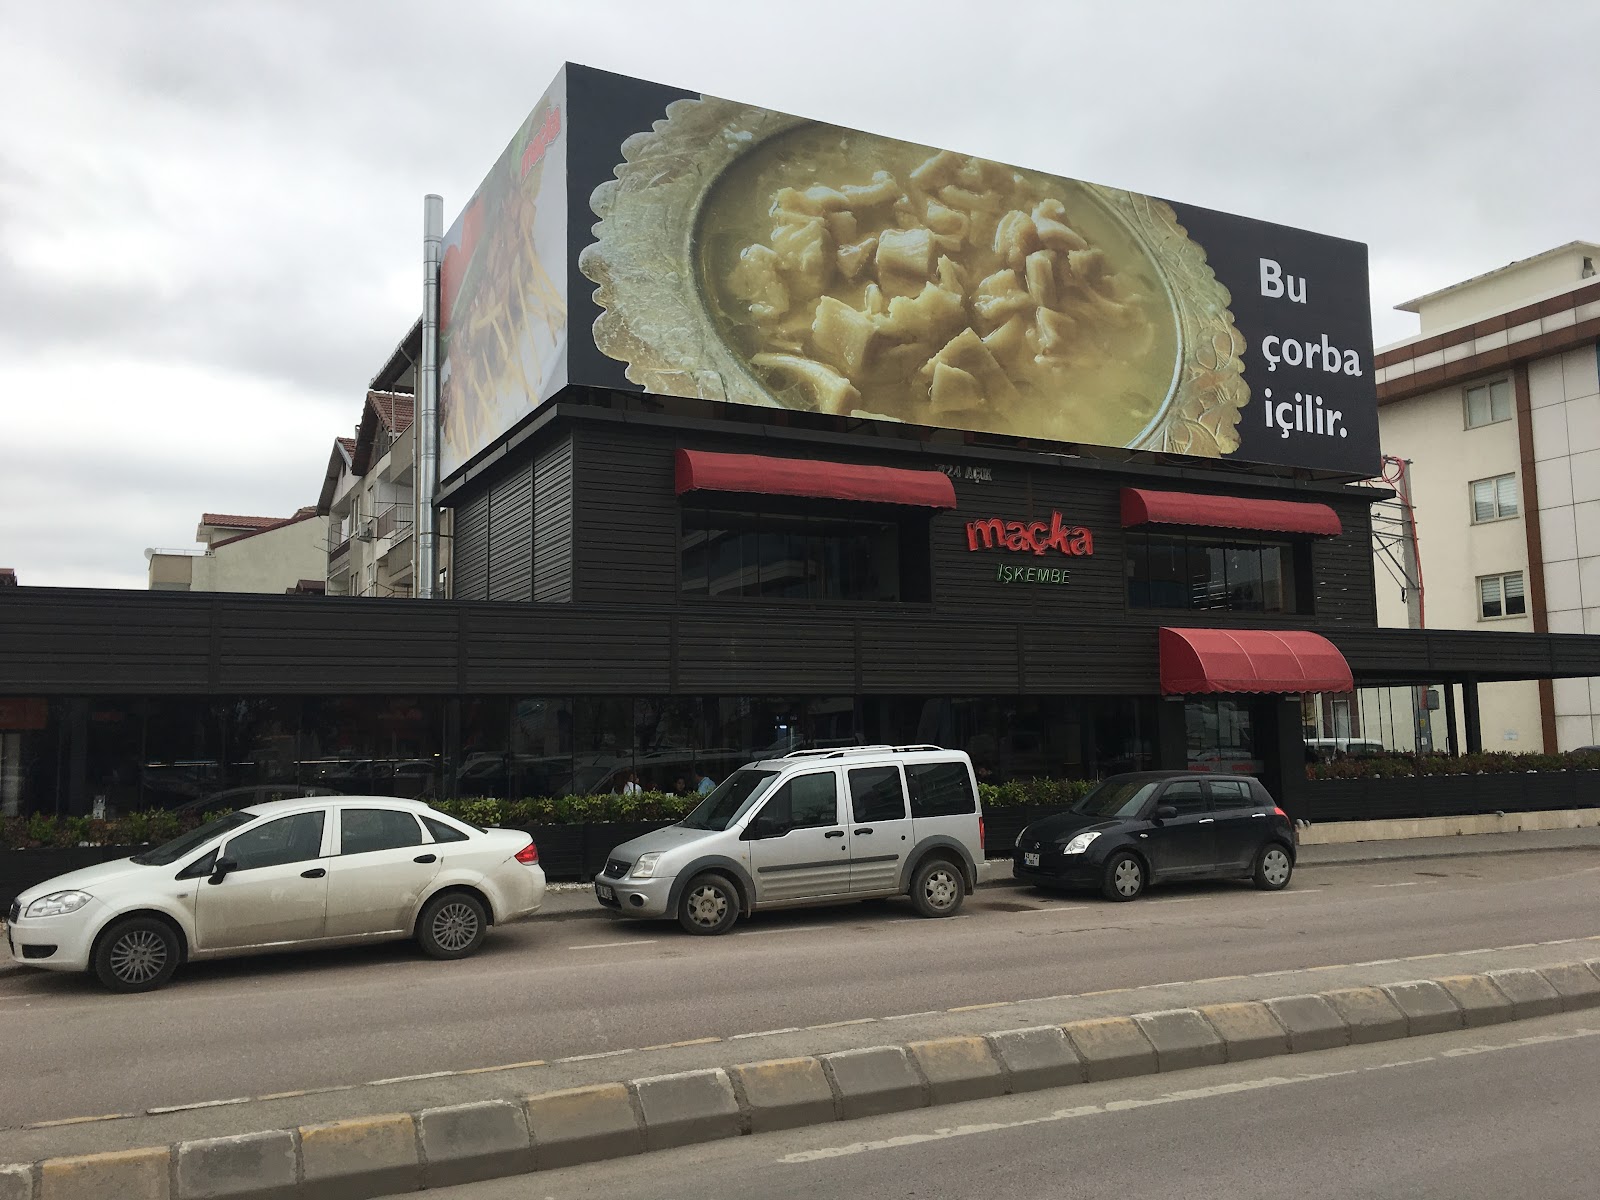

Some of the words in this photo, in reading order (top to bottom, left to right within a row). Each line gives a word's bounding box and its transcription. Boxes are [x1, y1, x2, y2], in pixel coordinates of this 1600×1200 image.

[1259, 257, 1307, 304] Bu
[1262, 333, 1363, 377] çorba
[1264, 387, 1348, 439] içilir.
[965, 509, 1094, 556] maçka
